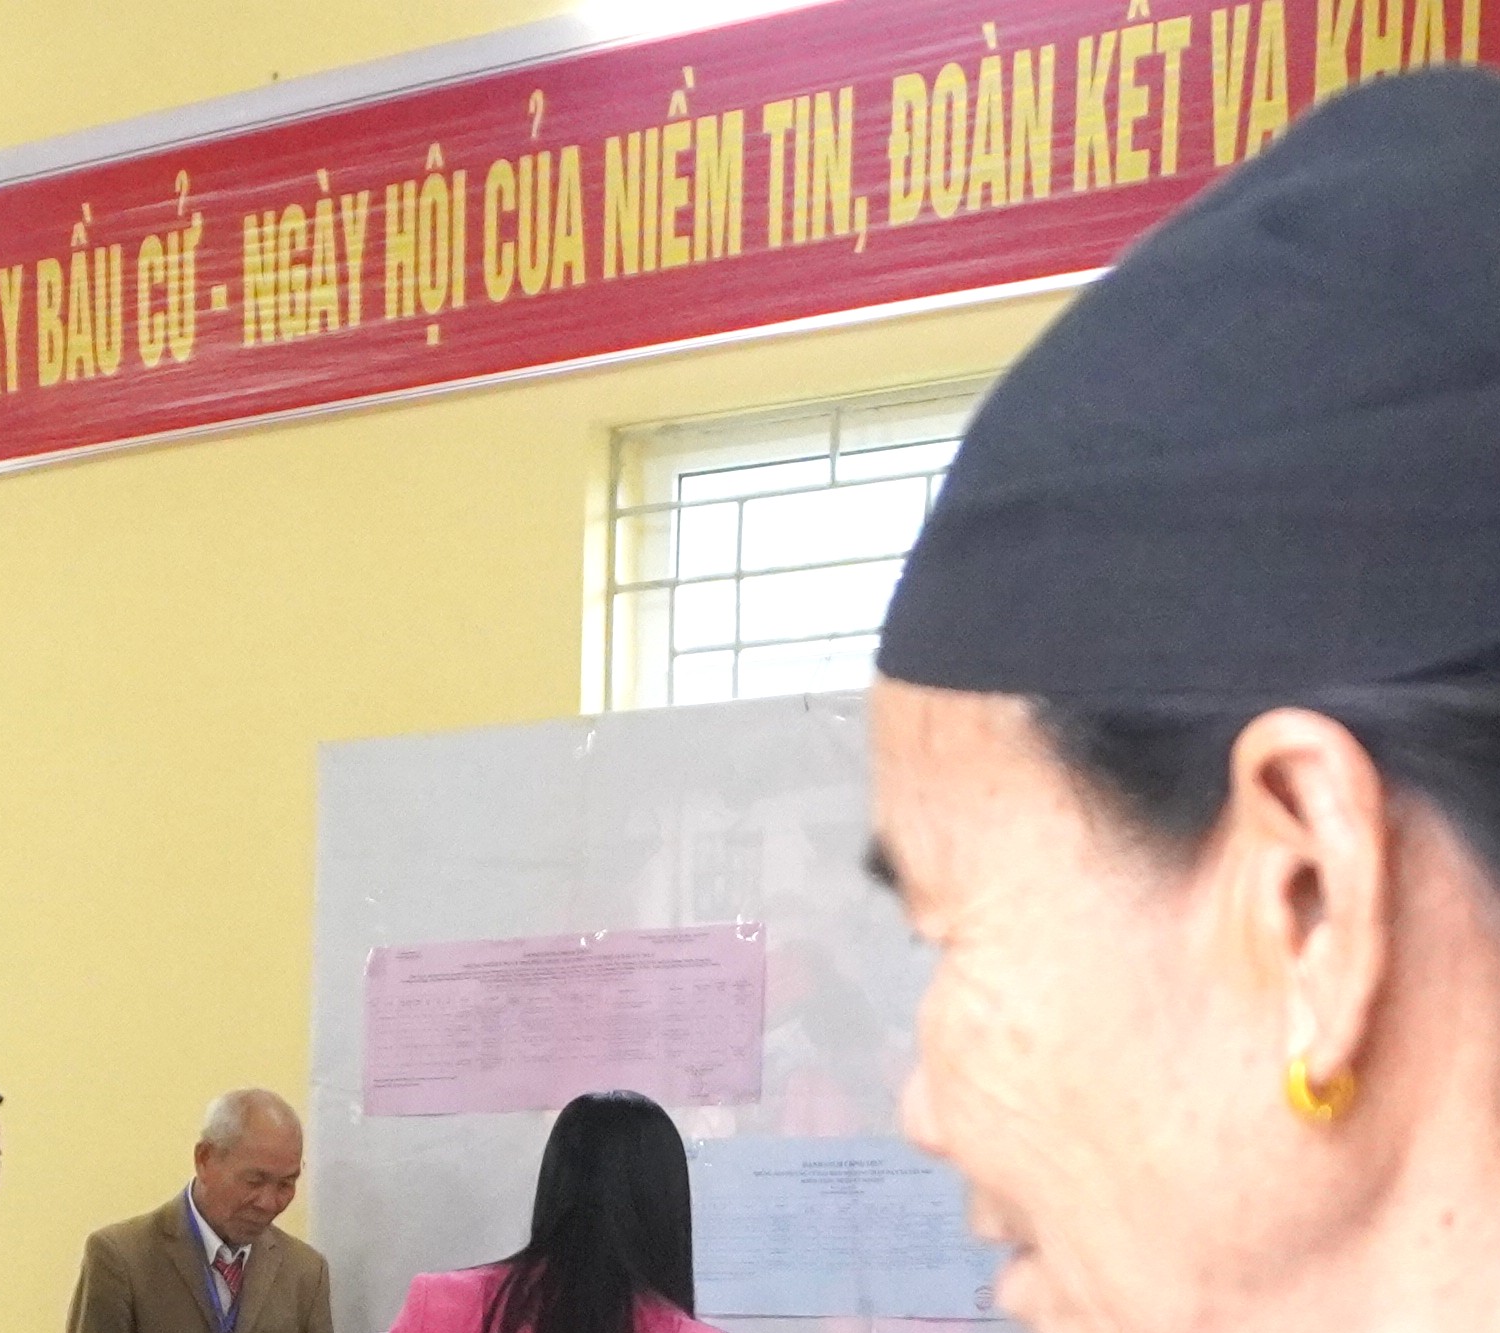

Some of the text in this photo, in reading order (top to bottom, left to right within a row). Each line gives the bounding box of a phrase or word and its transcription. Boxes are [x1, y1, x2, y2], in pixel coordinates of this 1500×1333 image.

[36, 202, 122, 387] BẦU
[137, 169, 203, 368] CỬ
[210, 284, 228, 311] -
[243, 168, 369, 348] NGÀY
[385, 142, 467, 346] HỘI
[483, 88, 586, 302] CỦA
[602, 65, 744, 279] NIỀM
[762, 85, 868, 254] TIN,
[888, 21, 1056, 227] ĐOÀN
